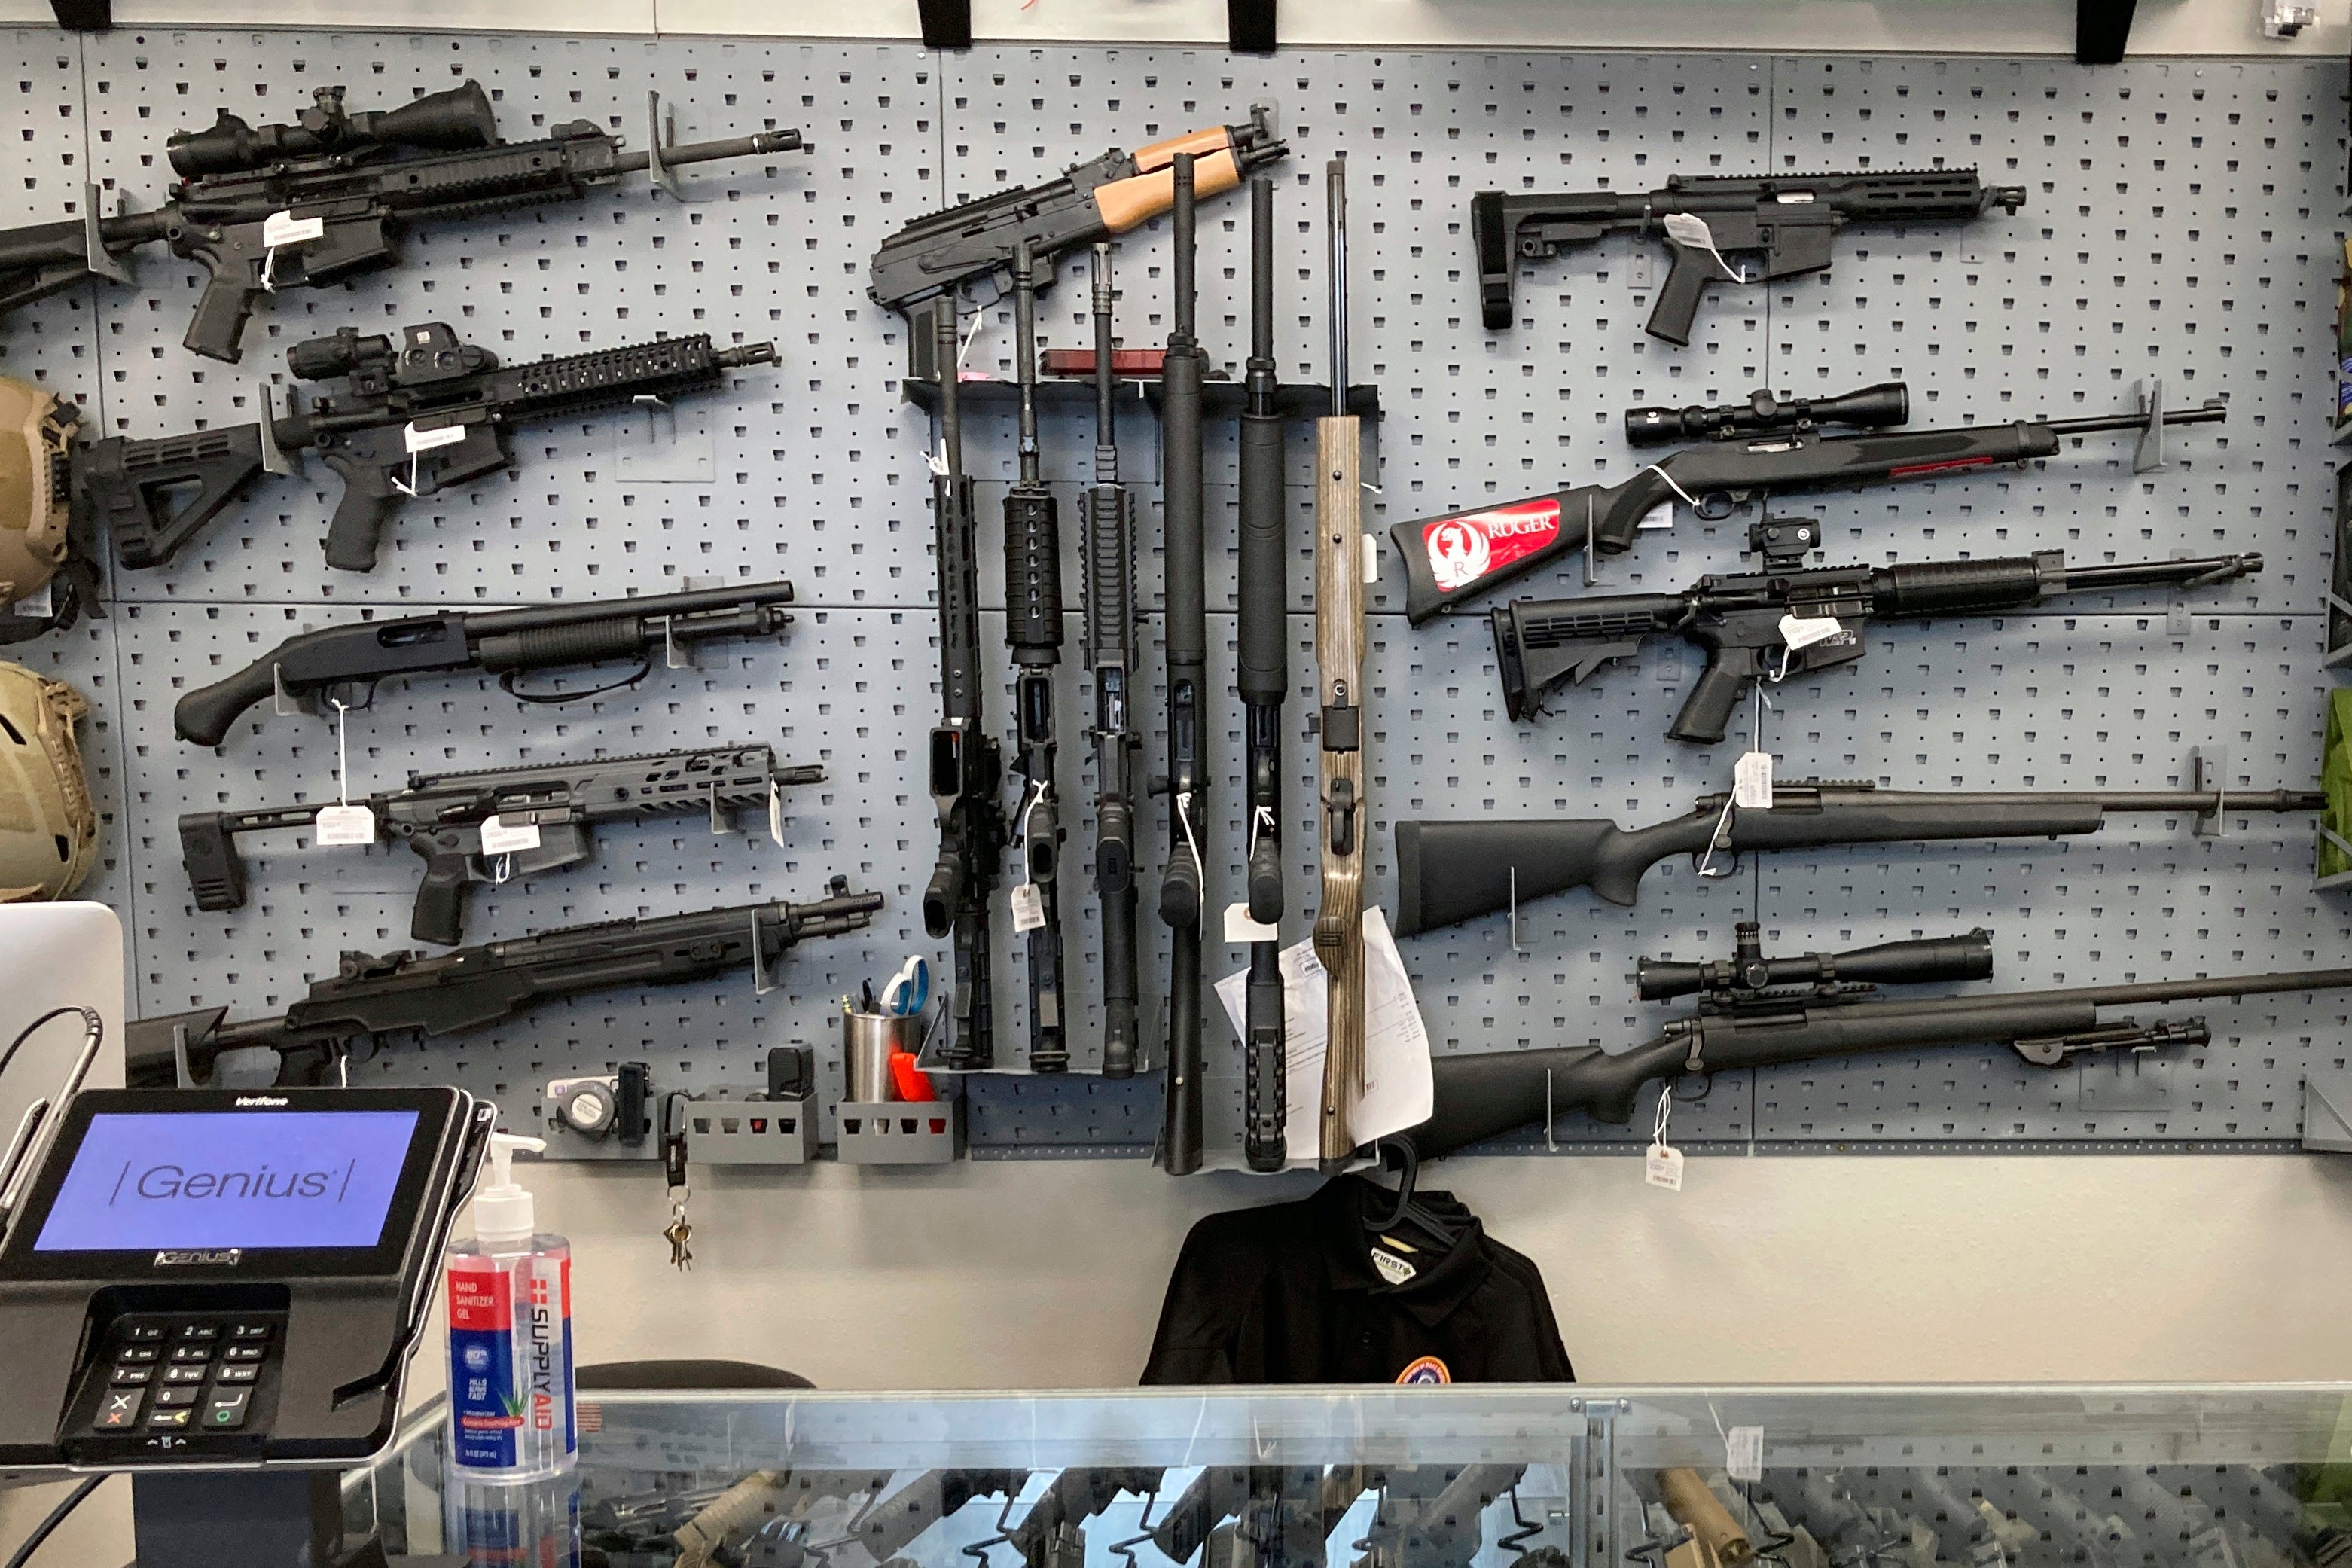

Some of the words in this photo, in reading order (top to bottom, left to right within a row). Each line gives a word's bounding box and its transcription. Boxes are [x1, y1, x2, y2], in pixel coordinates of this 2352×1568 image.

[1487, 516, 1556, 539] RUGER
[1453, 561, 1469, 578] R
[236, 1096, 289, 1106] Verifone
[137, 1164, 329, 1199] Genius
[1372, 1252, 1403, 1271] FIRST
[456, 1282, 478, 1293] HAND
[456, 1295, 494, 1307] SANITIZER
[456, 1309, 470, 1319] GEL
[163, 1391, 172, 1401] 0
